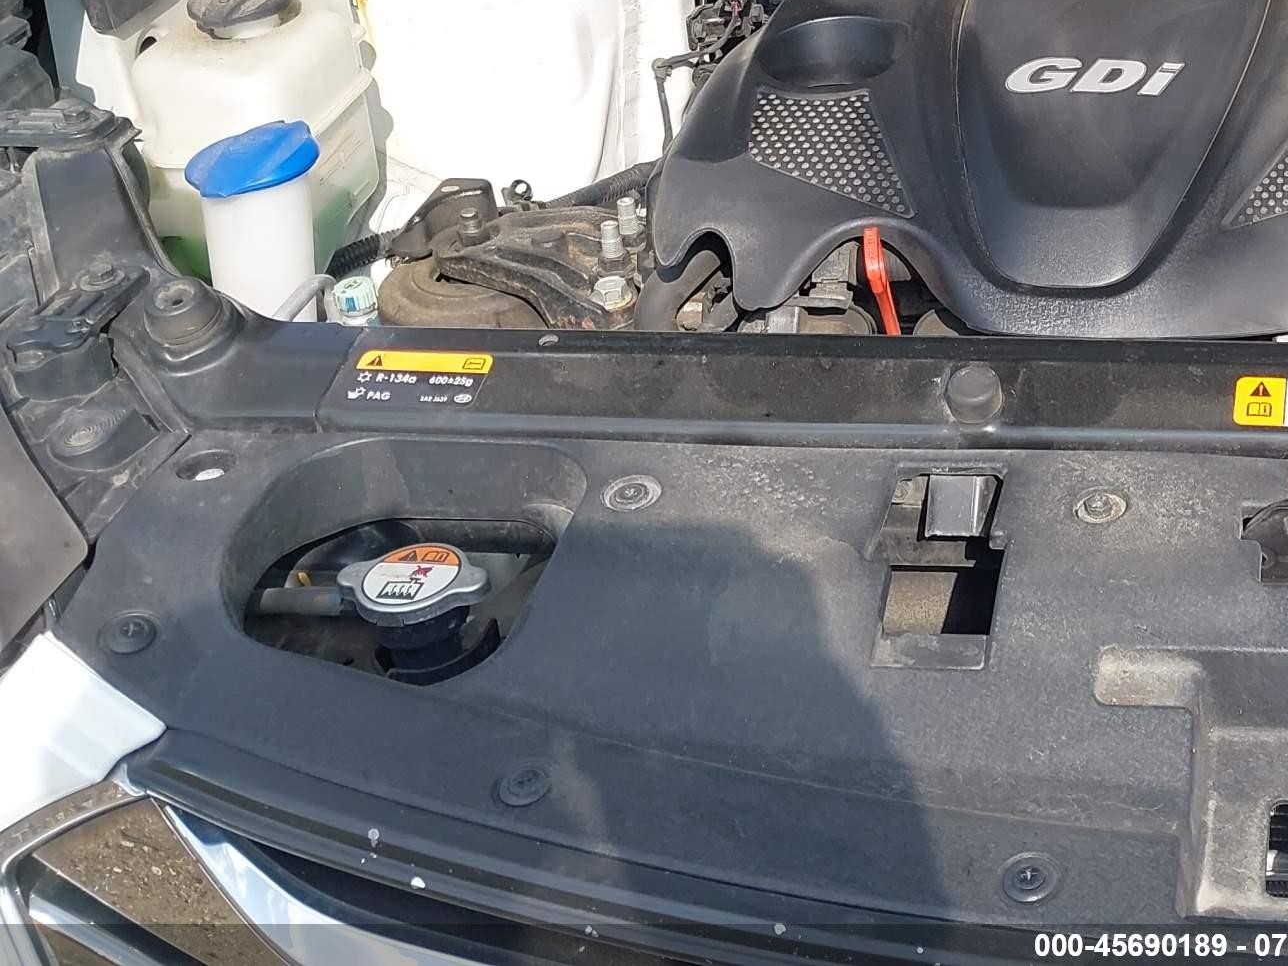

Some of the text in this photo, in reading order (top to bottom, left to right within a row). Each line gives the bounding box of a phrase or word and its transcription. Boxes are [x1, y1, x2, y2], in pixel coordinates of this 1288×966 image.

[1004, 56, 1185, 96] GDi
[376, 372, 474, 388] R-134a 600±25g
[366, 390, 391, 401] PAG
